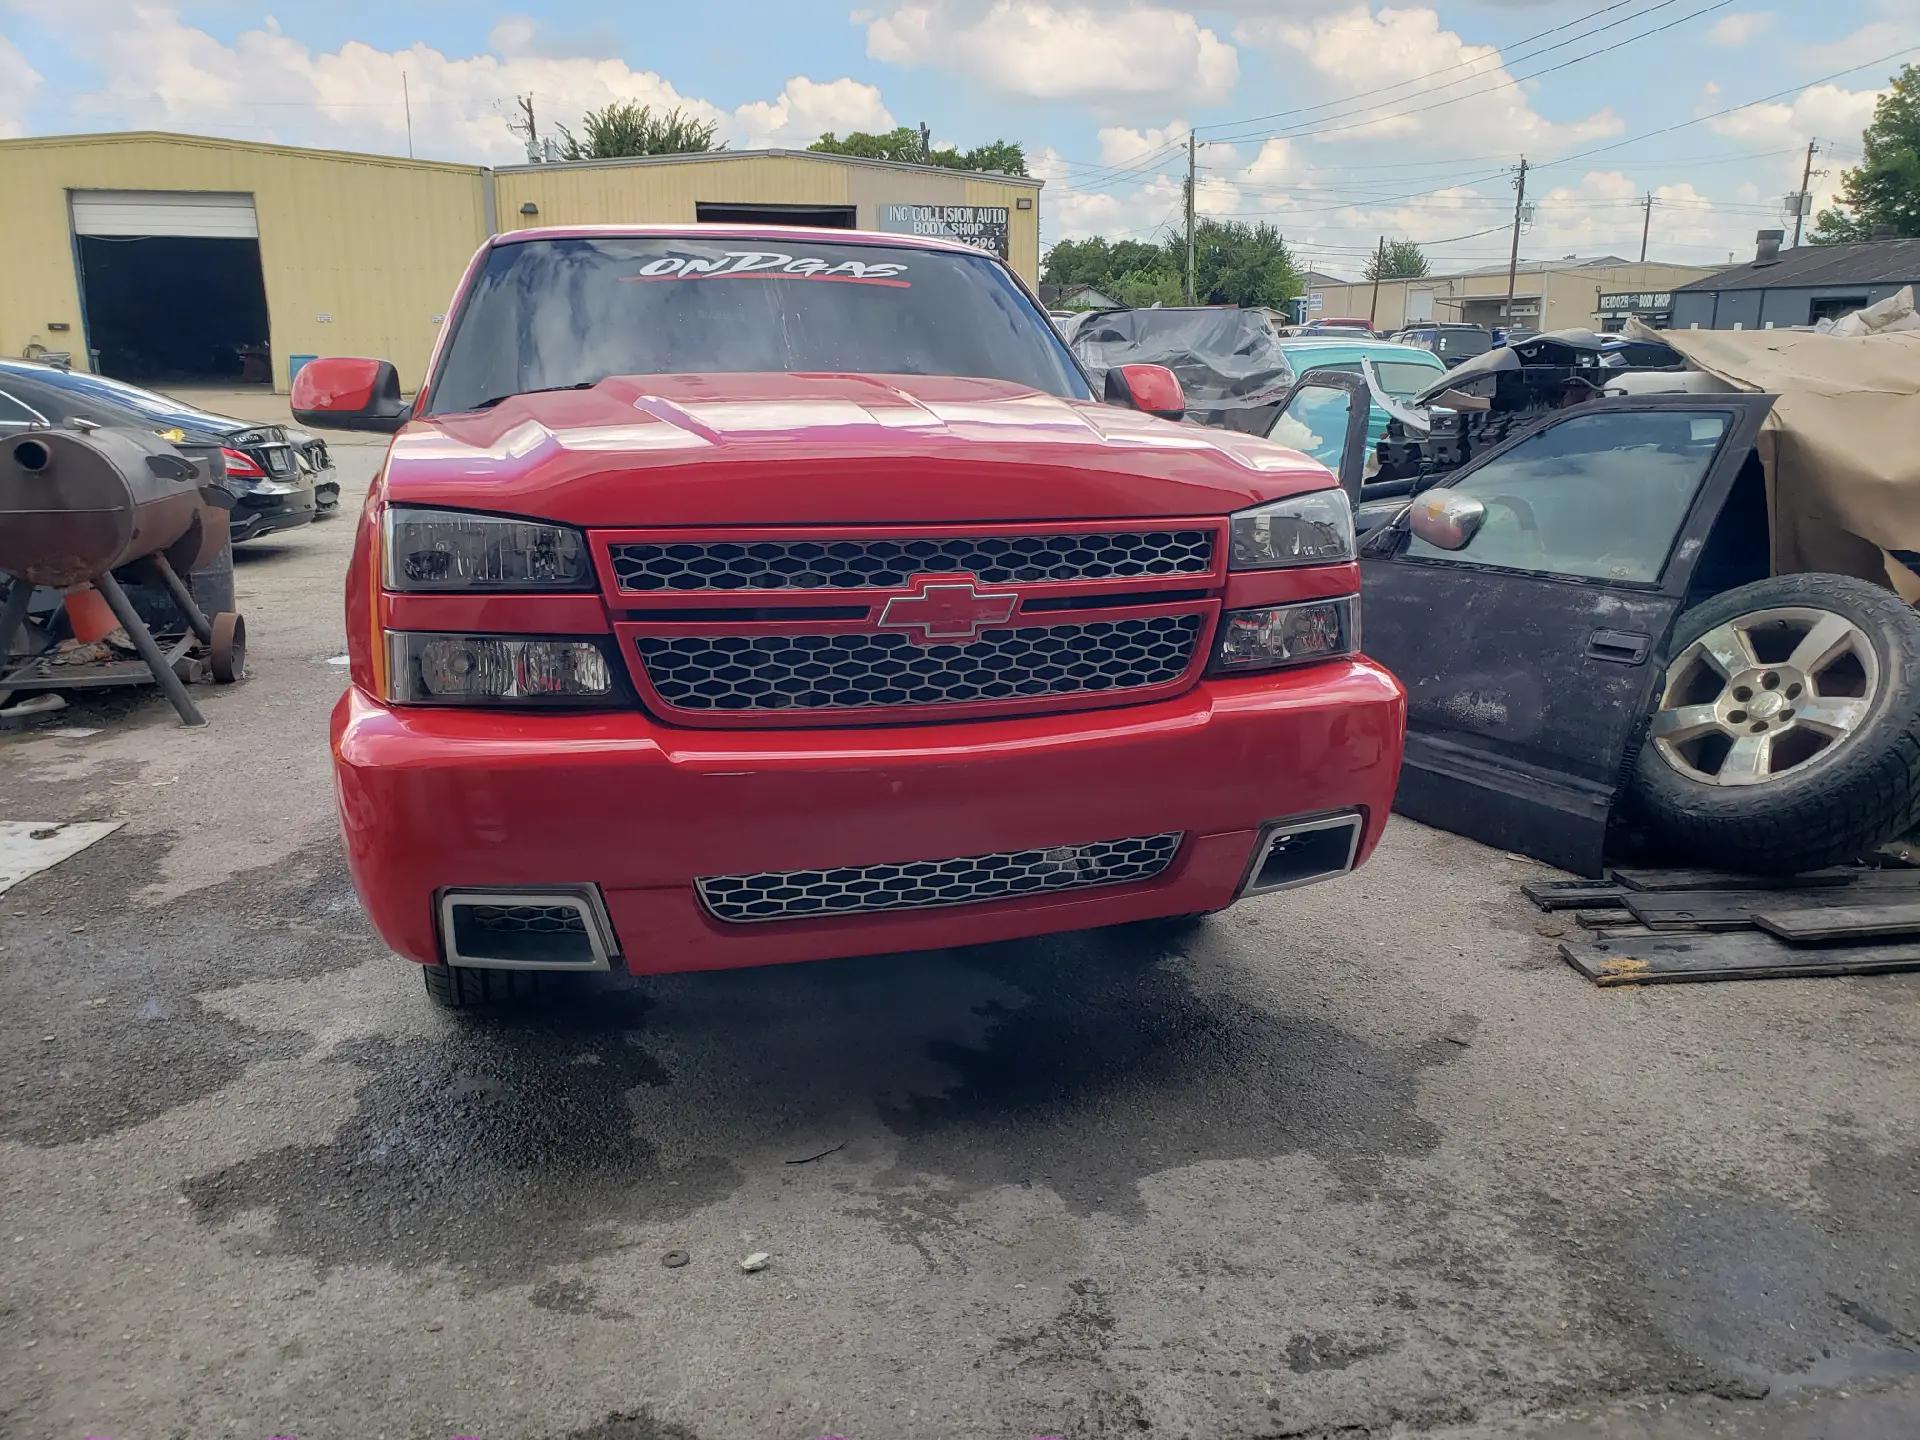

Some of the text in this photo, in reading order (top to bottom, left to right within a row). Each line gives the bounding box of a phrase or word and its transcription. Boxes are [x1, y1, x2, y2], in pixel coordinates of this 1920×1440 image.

[912, 206, 973, 223] COLLISION
[976, 208, 1007, 223] AUTO
[913, 222, 984, 235] BODY SHOP
[1639, 294, 1654, 307] BODY
[1654, 293, 1670, 307] SHOP
